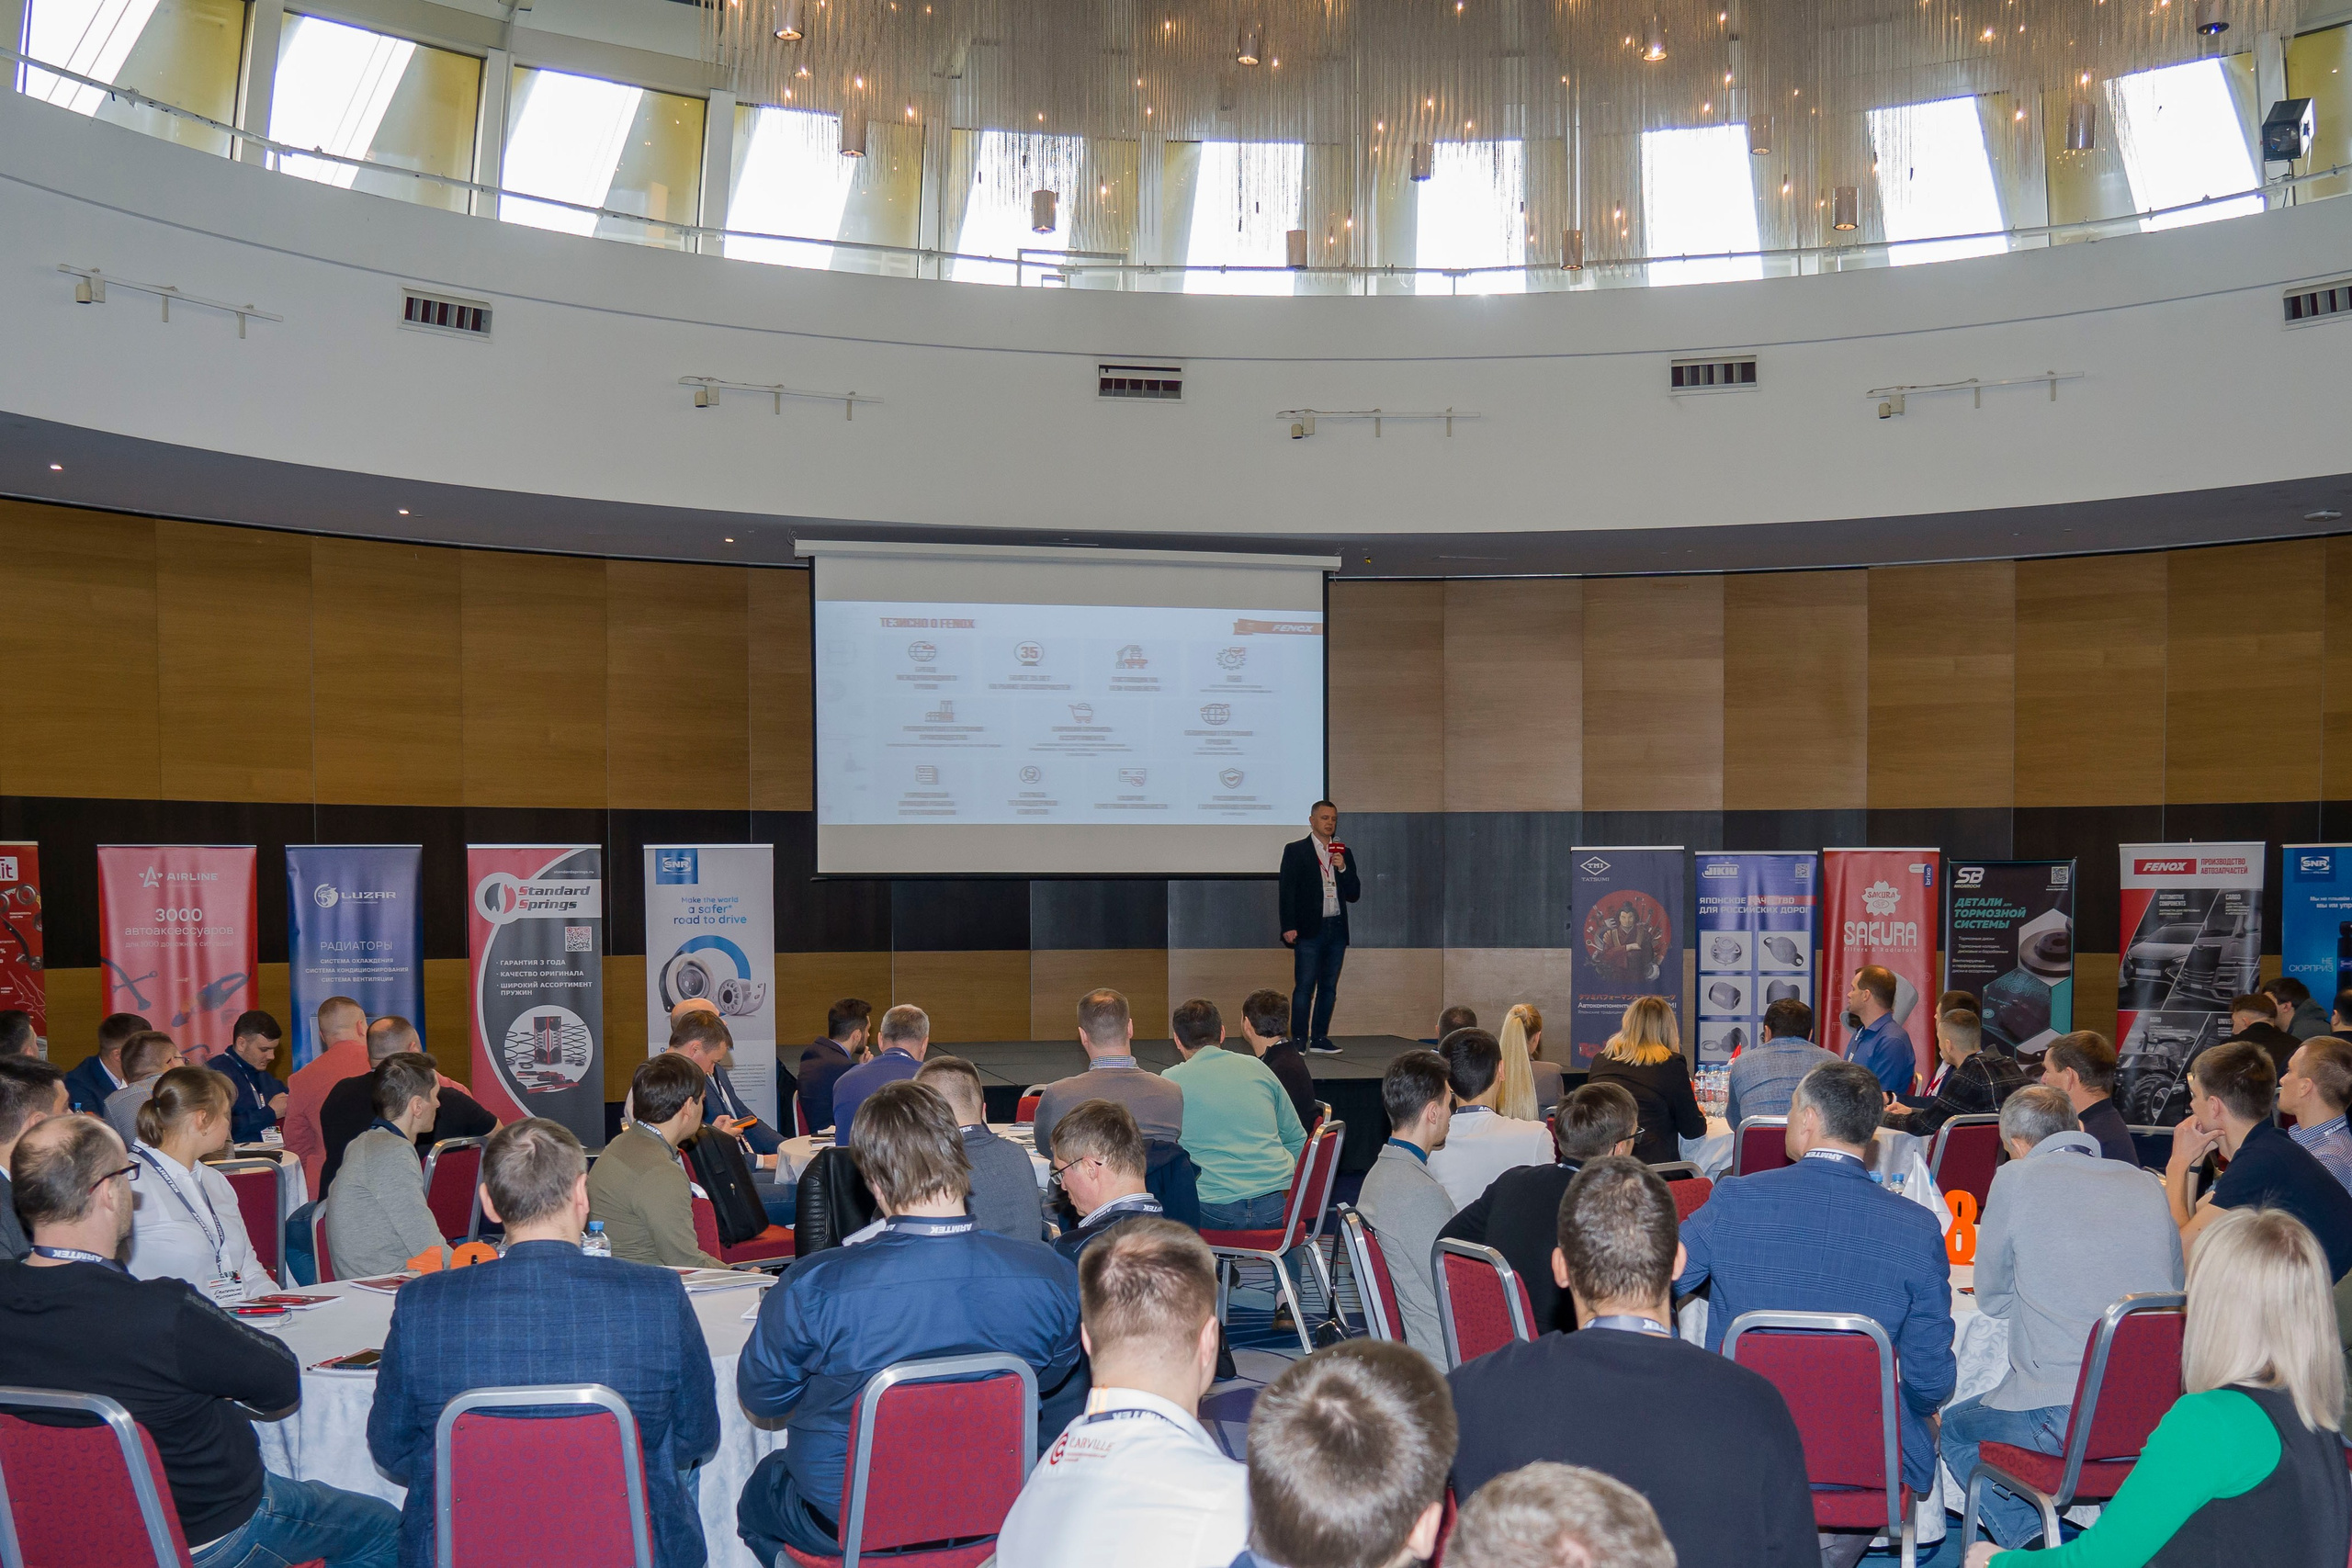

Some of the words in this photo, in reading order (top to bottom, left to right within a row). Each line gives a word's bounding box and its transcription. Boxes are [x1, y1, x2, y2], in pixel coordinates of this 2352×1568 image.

[880, 617, 929, 628] ТЕЗИСНО
[939, 619, 976, 629] FENOX
[1272, 624, 1315, 633] FENOX
[1021, 646, 1038, 659] 35
[2143, 862, 2187, 872] FENOX
[2200, 858, 2246, 866] ПРОИЗВОДСТВО
[1955, 867, 1984, 884] SB
[2200, 866, 2248, 874] АВТОЗАПЧАСТЕЙ
[166, 873, 219, 881] AIRLINE
[341, 891, 397, 899] LUZAR
[518, 886, 591, 896] Standard
[518, 899, 578, 911] Springs
[1954, 897, 2003, 908] ДЕТАЛИ
[155, 908, 203, 922] 3000
[1699, 907, 1718, 915] ДЛЯ
[1721, 905, 1778, 914] РОССИЙСКИХ
[1780, 907, 1809, 915] ДОРОГ
[1954, 907, 2027, 918] ТОРМОЗНОЙ
[673, 915, 700, 924] road
[704, 916, 716, 924] to
[718, 915, 747, 924] drive
[1953, 919, 2010, 929] СИСТЕМЫ
[124, 927, 234, 938] автоаксессуаров
[1843, 920, 1917, 946] SAKURA
[320, 941, 393, 952] РАДИАТОРЫ
[2289, 964, 2334, 972] СЮРПРИЗ
[1804, 1150, 1844, 1161] ARMTEK
[154, 1165, 181, 1194] ARMTEK
[191, 1212, 214, 1241] ARMTEK
[930, 1223, 973, 1235] ARMTEK
[1943, 1189, 1978, 1265] 8
[51, 1249, 103, 1263] ARMTEK
